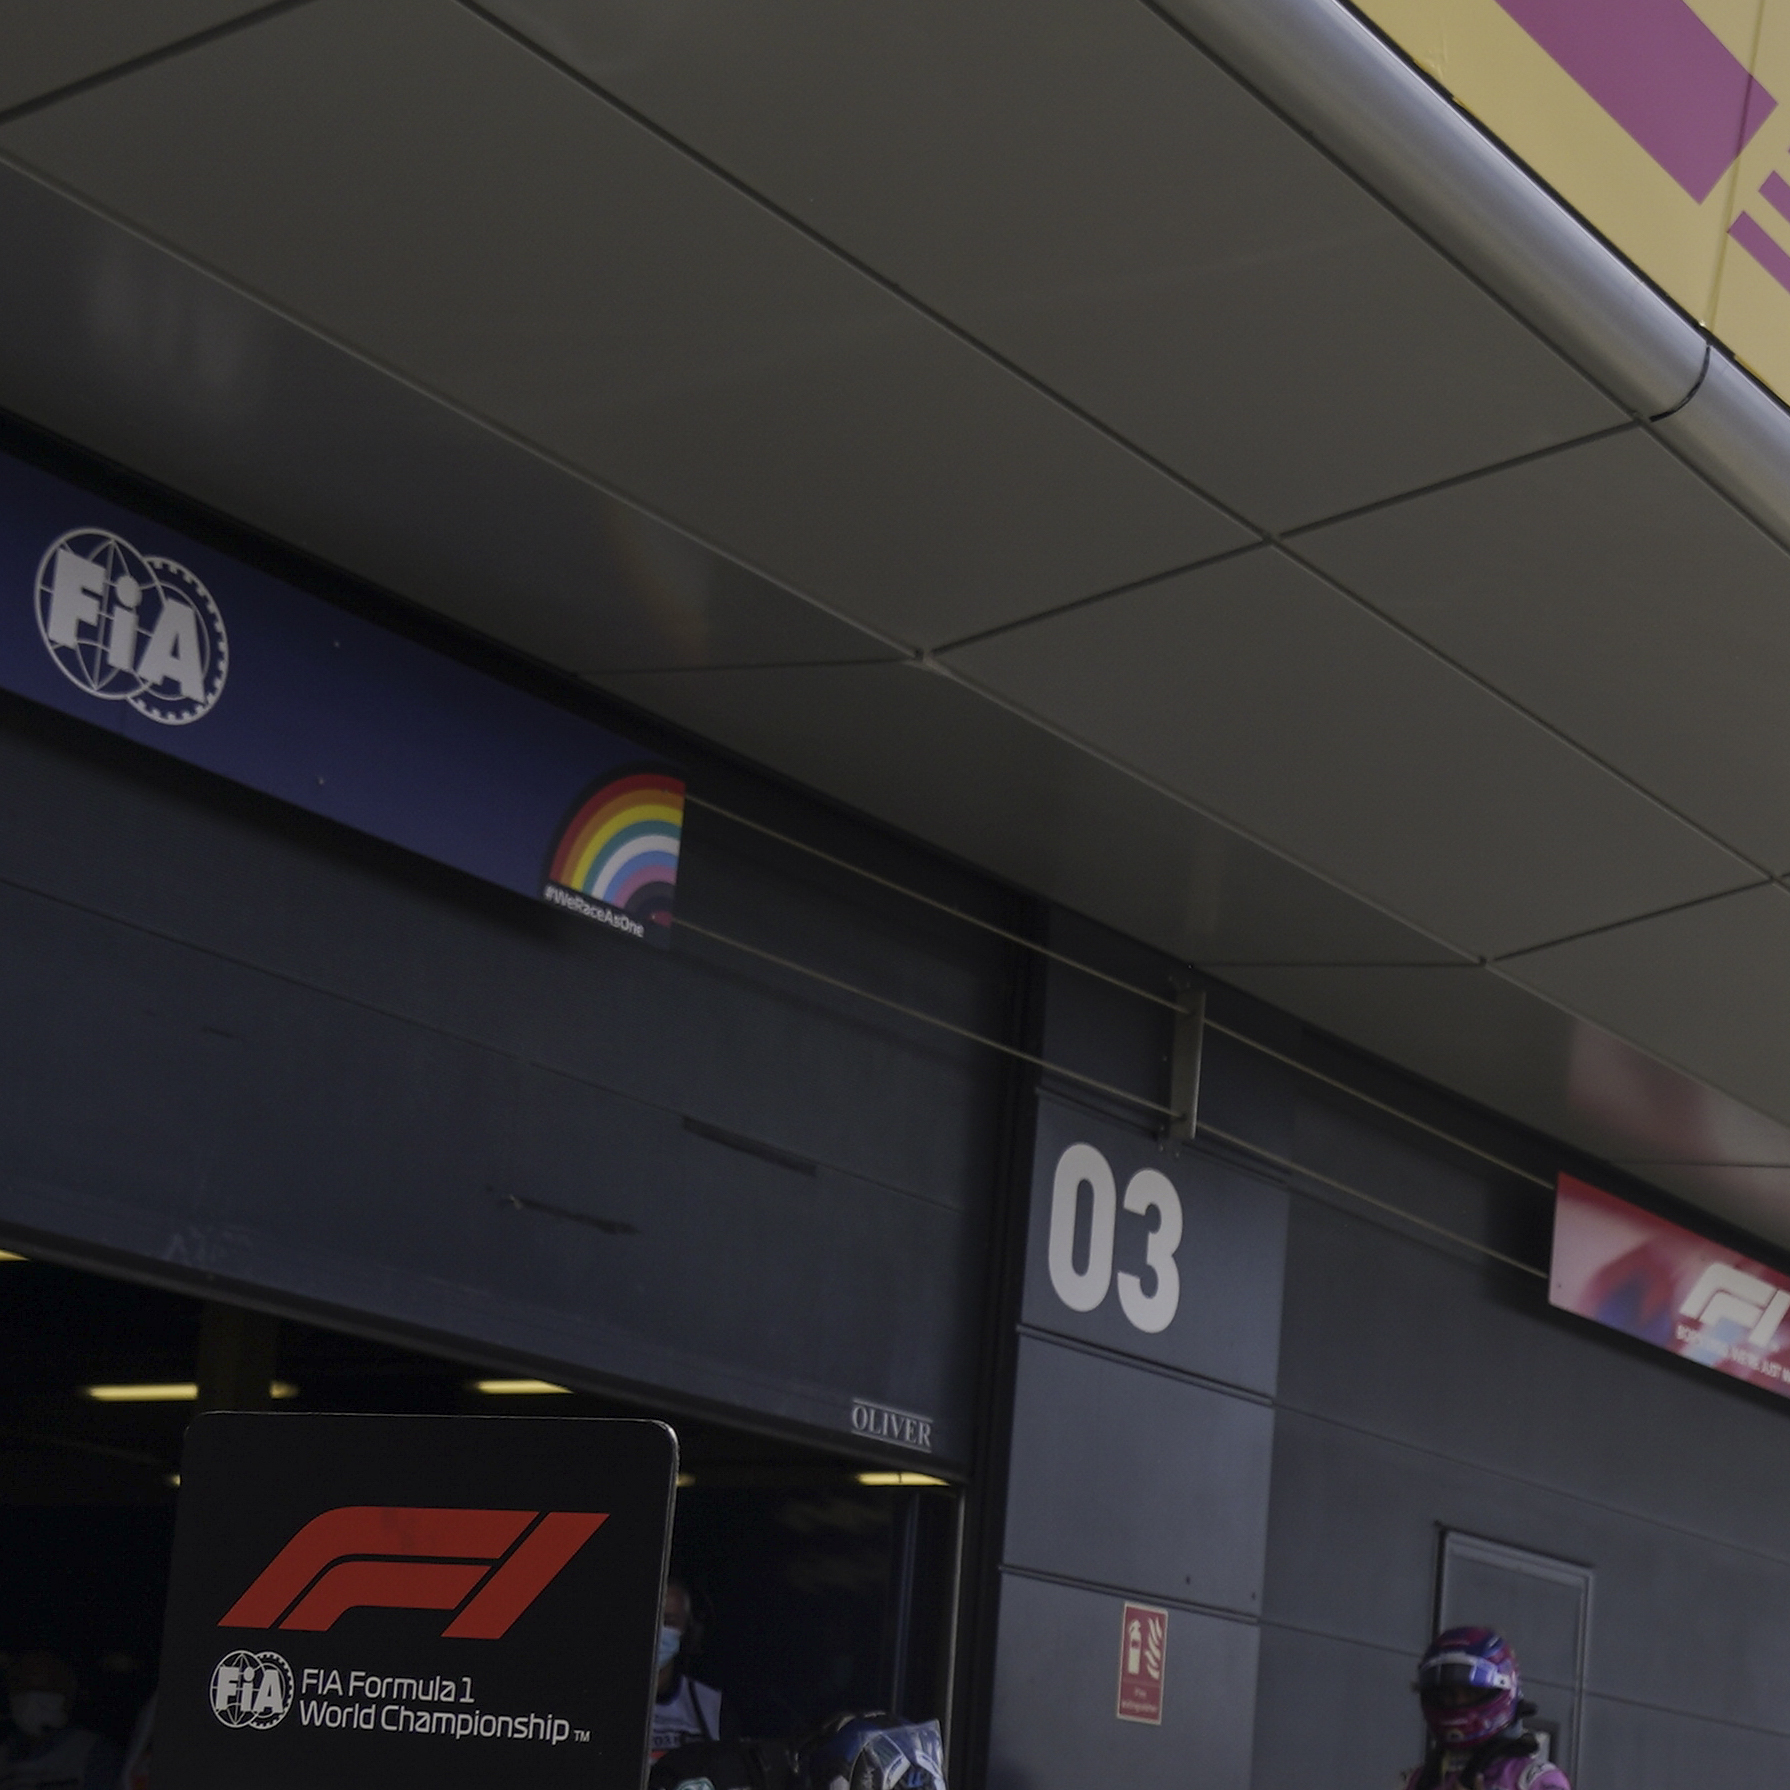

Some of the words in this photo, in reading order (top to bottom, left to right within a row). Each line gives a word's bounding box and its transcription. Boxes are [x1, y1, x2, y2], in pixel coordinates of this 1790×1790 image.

[543, 883, 645, 940] #WeRaceAsOne
[1048, 1142, 1183, 1333] 03
[852, 1404, 932, 1448] OLIVER
[216, 1506, 610, 1640] F1
[301, 1668, 344, 1696] FIA
[348, 1670, 453, 1703] Formula
[459, 1677, 475, 1703] 1
[299, 1700, 375, 1731] World
[381, 1705, 570, 1746] Championship
